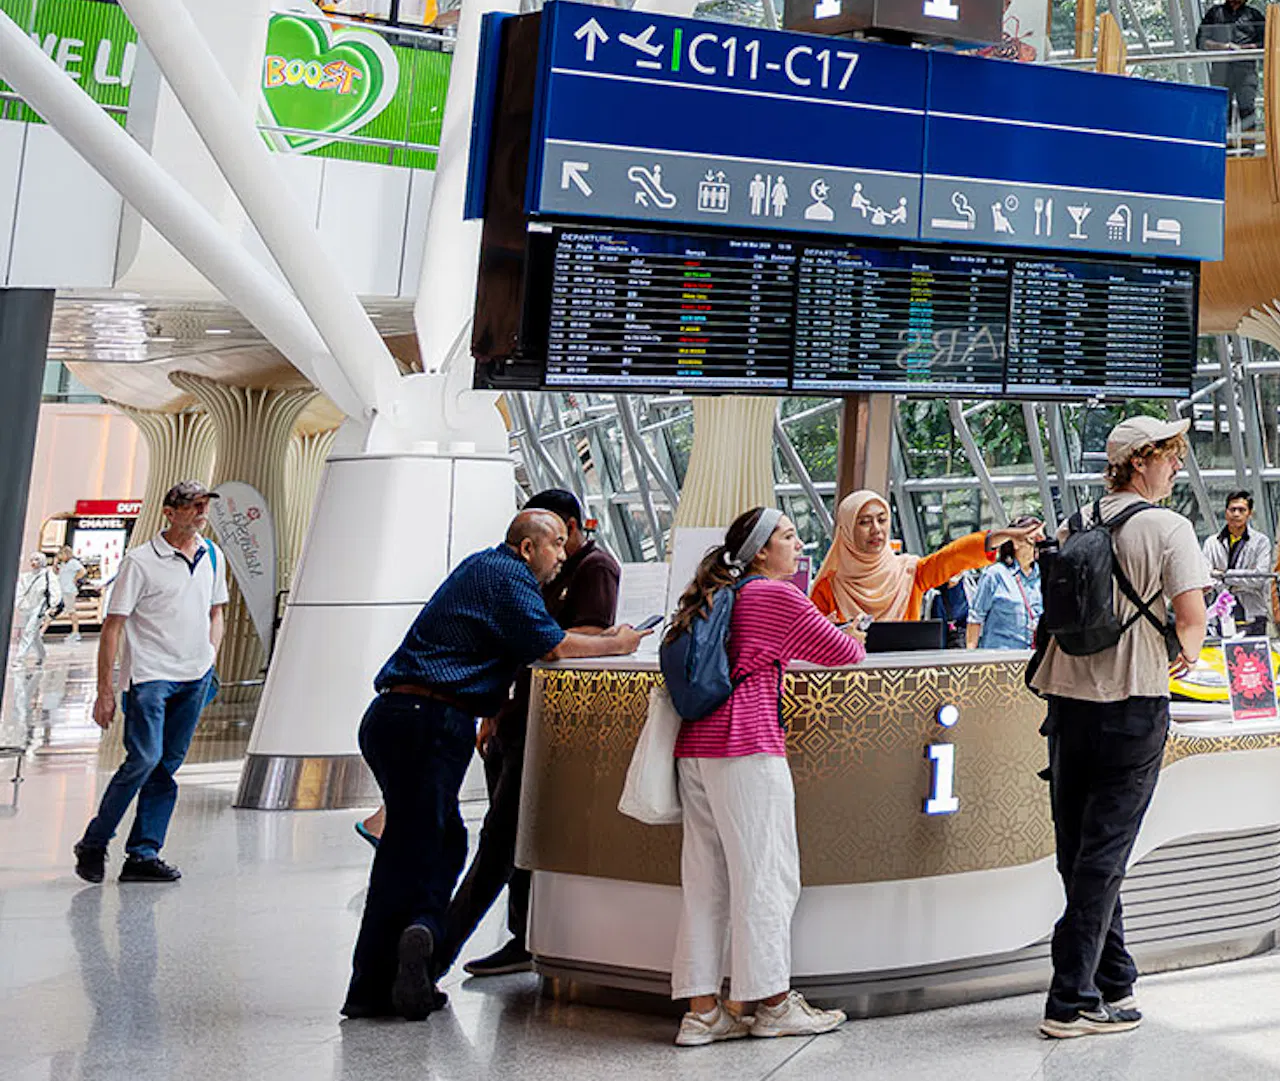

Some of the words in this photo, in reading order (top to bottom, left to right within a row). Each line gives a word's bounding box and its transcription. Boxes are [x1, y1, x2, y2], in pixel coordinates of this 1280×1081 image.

[265, 56, 363, 94] BOOST
[689, 31, 860, 92] C11-C17
[926, 705, 960, 816] i
